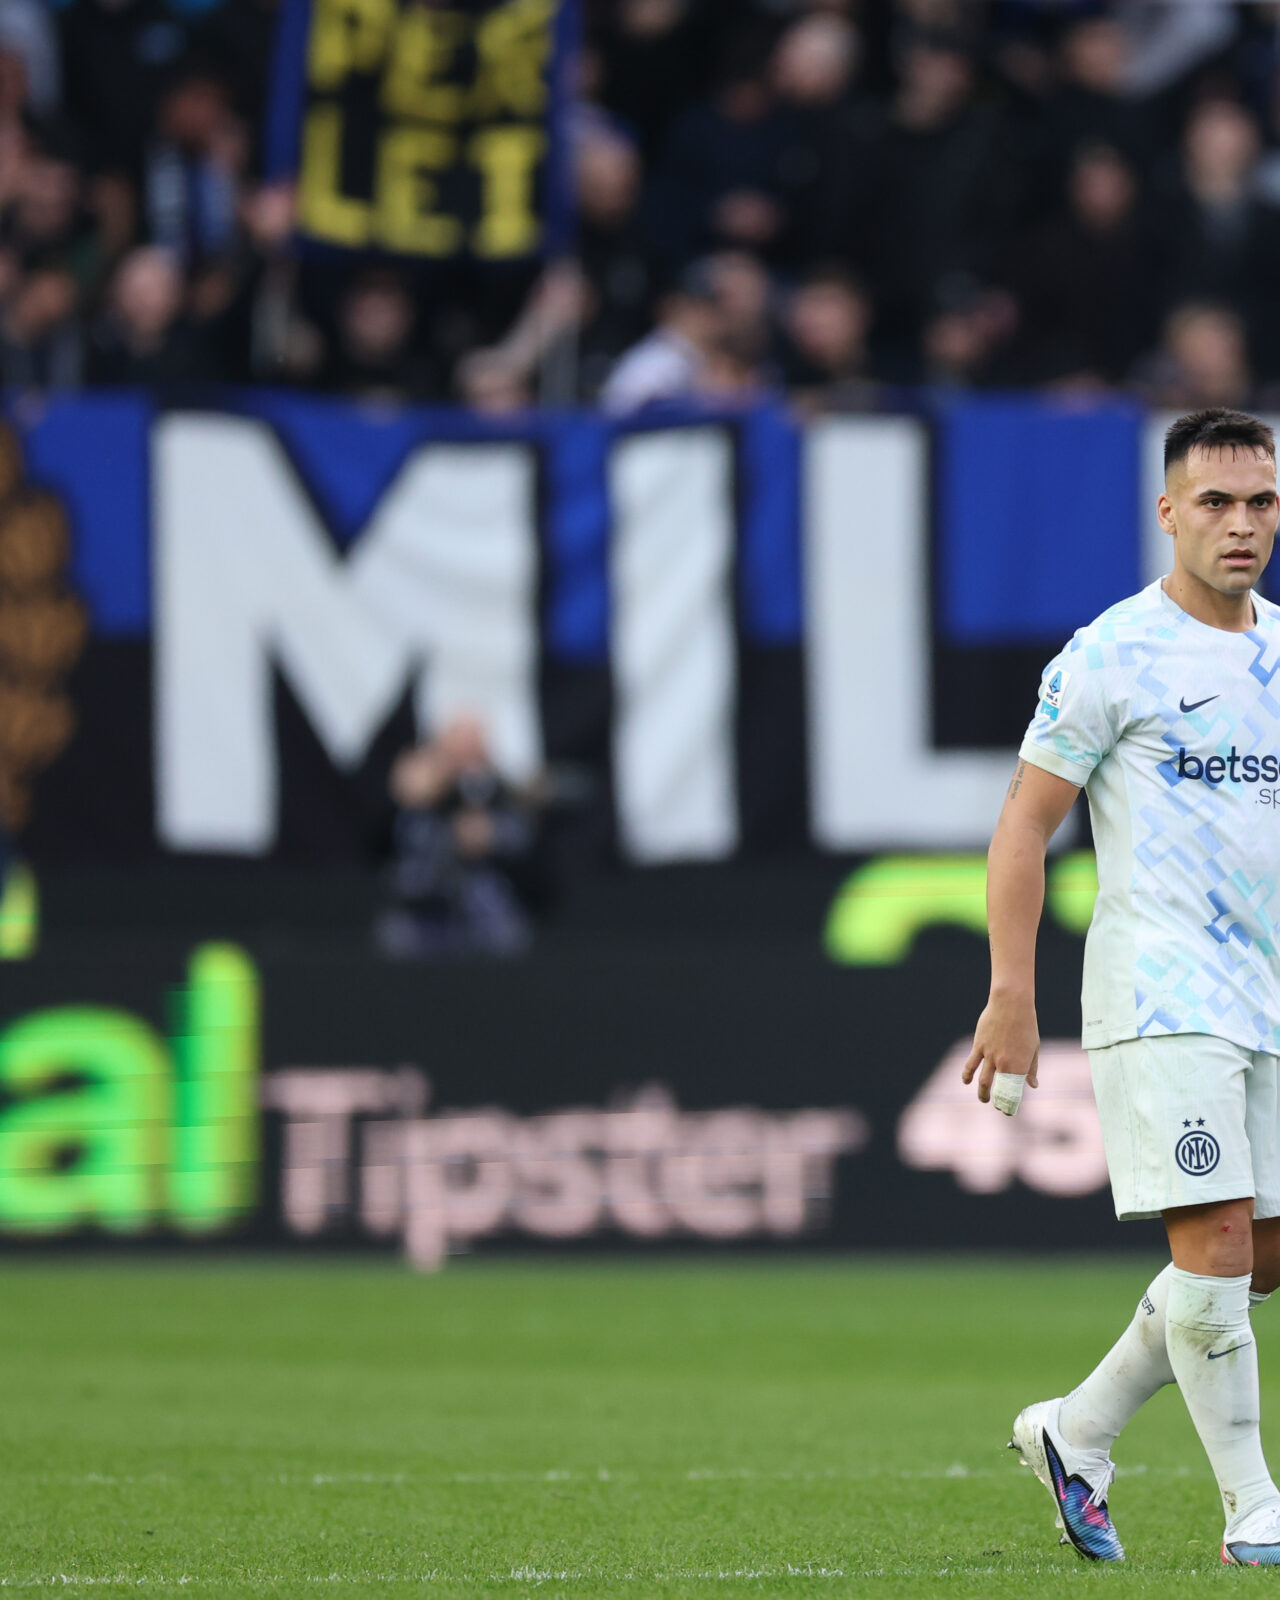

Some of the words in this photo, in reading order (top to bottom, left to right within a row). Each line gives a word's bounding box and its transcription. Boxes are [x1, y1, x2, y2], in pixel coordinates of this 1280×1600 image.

[302, 102, 548, 259] LEI
[264, 1067, 868, 1273] Tipster
[1141, 1293, 1155, 1315] ER
